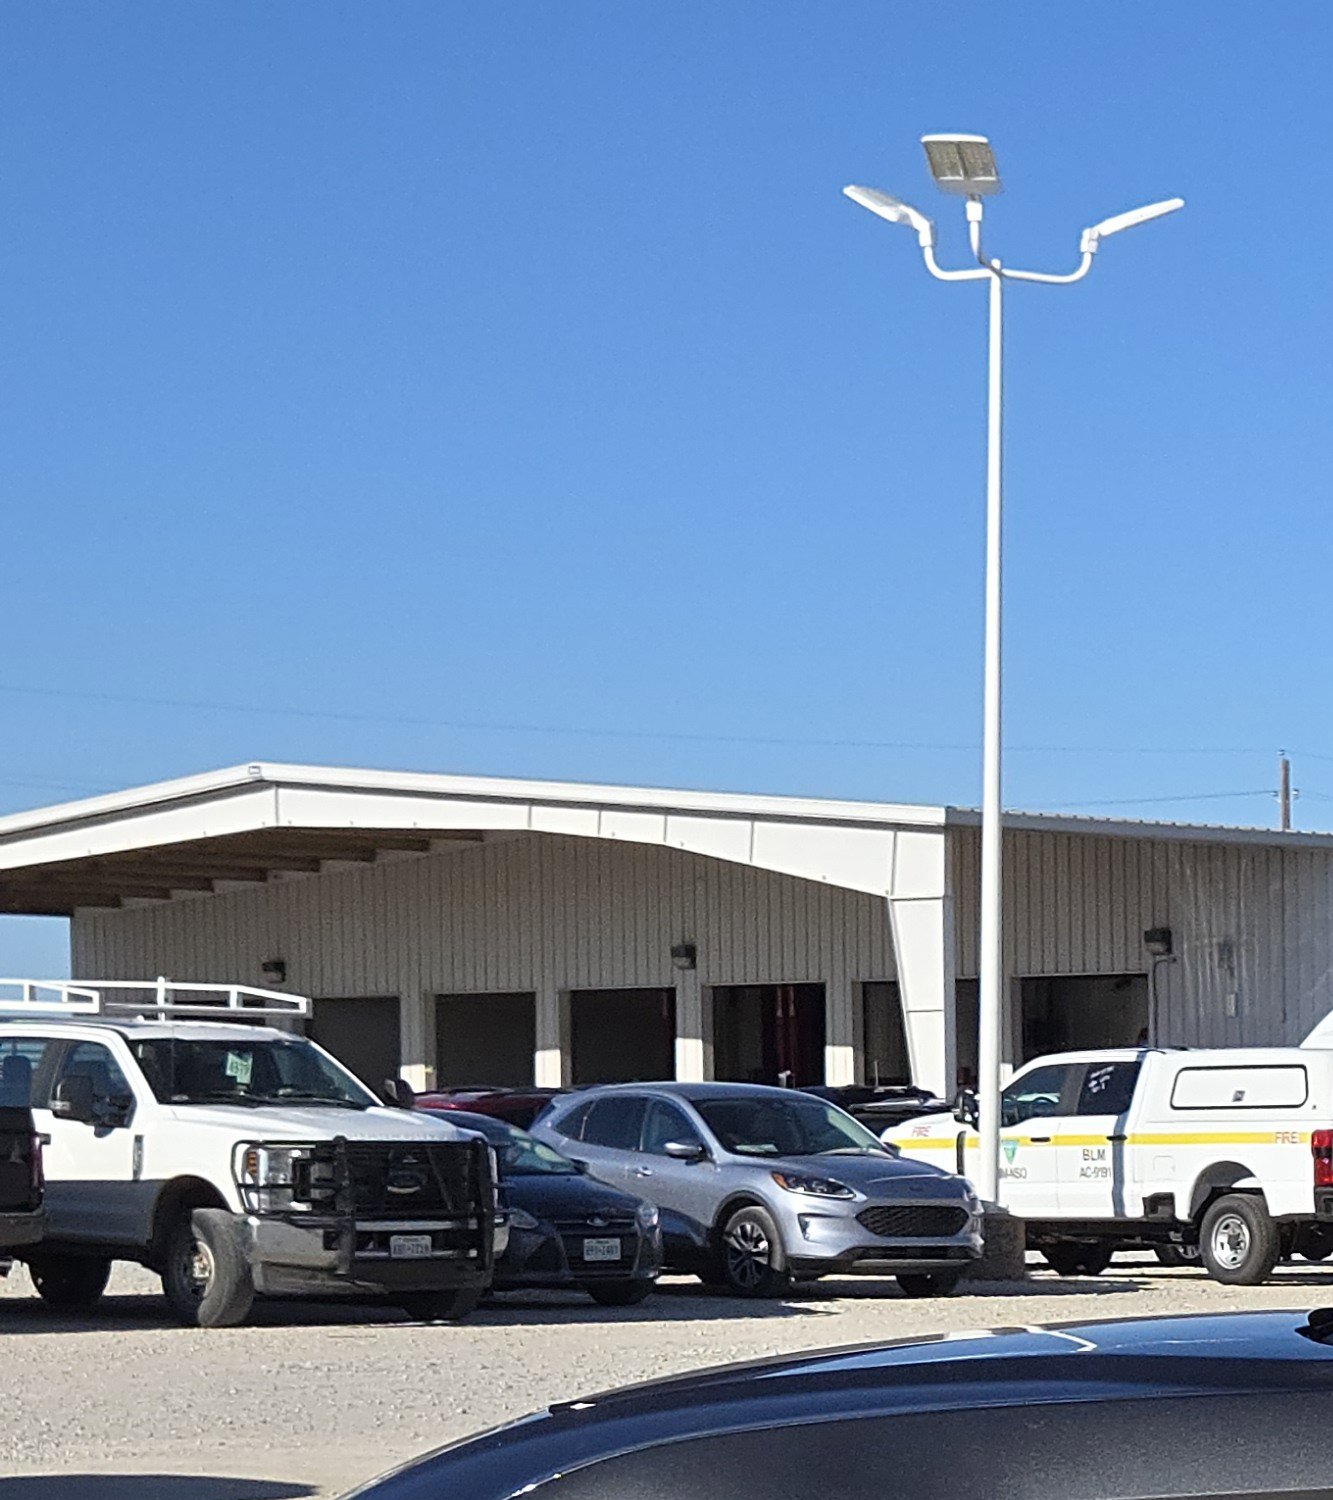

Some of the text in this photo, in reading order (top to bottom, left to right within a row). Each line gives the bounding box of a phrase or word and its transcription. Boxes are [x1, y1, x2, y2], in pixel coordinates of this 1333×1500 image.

[911, 1126, 931, 1137] FIRE
[1275, 1132, 1299, 1144] FIRE
[1082, 1148, 1106, 1161] BLM
